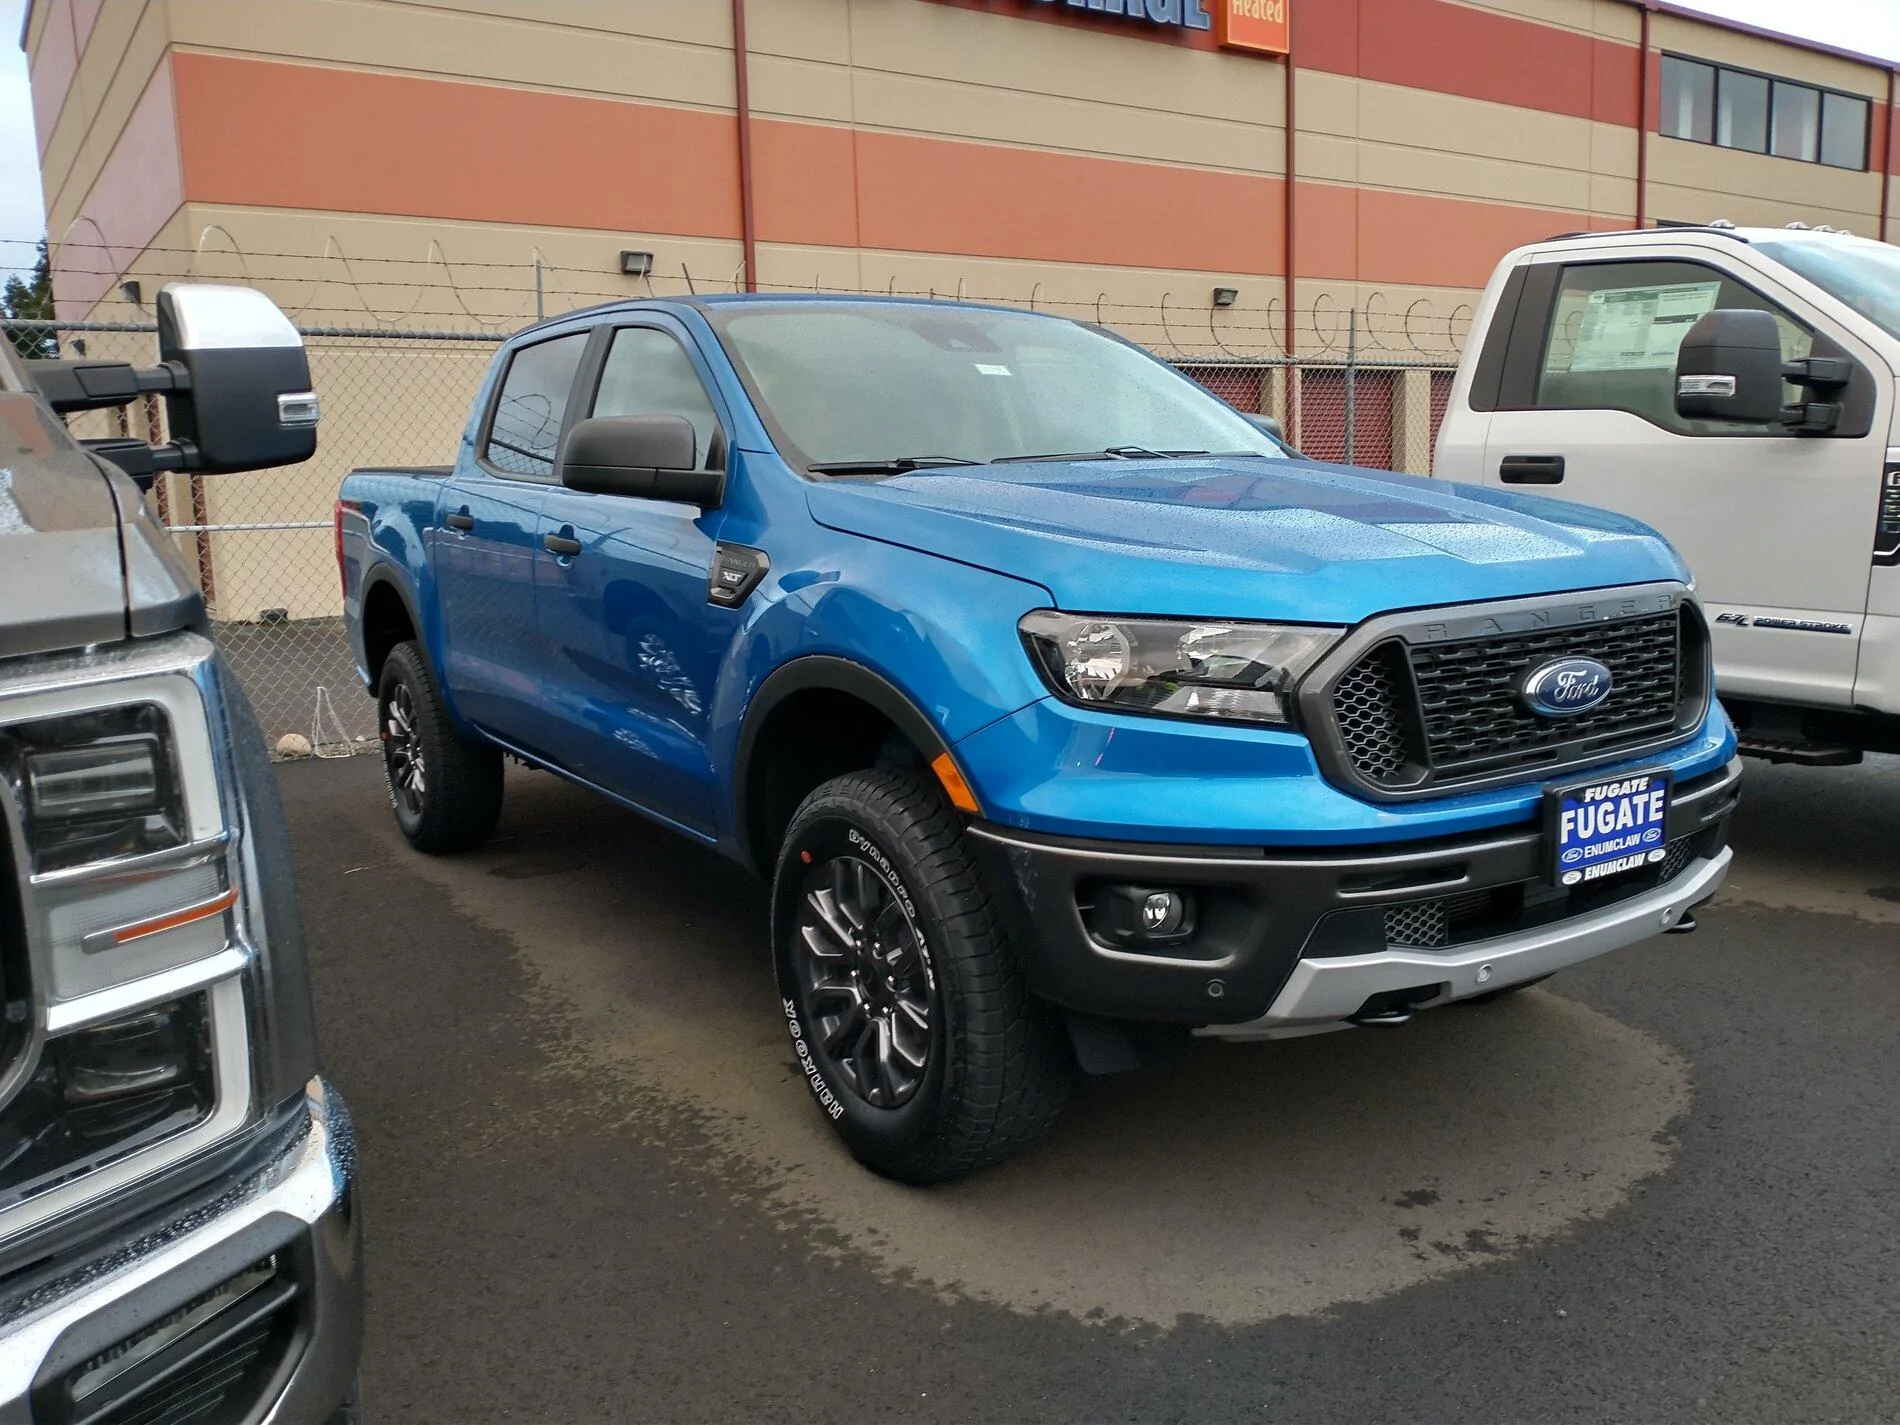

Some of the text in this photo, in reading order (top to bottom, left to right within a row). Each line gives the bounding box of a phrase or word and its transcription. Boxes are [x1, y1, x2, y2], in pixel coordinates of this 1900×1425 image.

[723, 571, 741, 582] XLT
[1424, 594, 1674, 640] RANGER
[1755, 616, 1796, 627] POWER
[1799, 619, 1849, 631] STROKE
[1584, 777, 1649, 802] FUGATE
[1561, 789, 1665, 844] FUGATE
[1584, 833, 1641, 858] ENUMCLAW
[849, 829, 915, 918] DYNAPRO
[1584, 852, 1646, 880] ENUMCLAW
[782, 997, 844, 1120] HANKOOK
